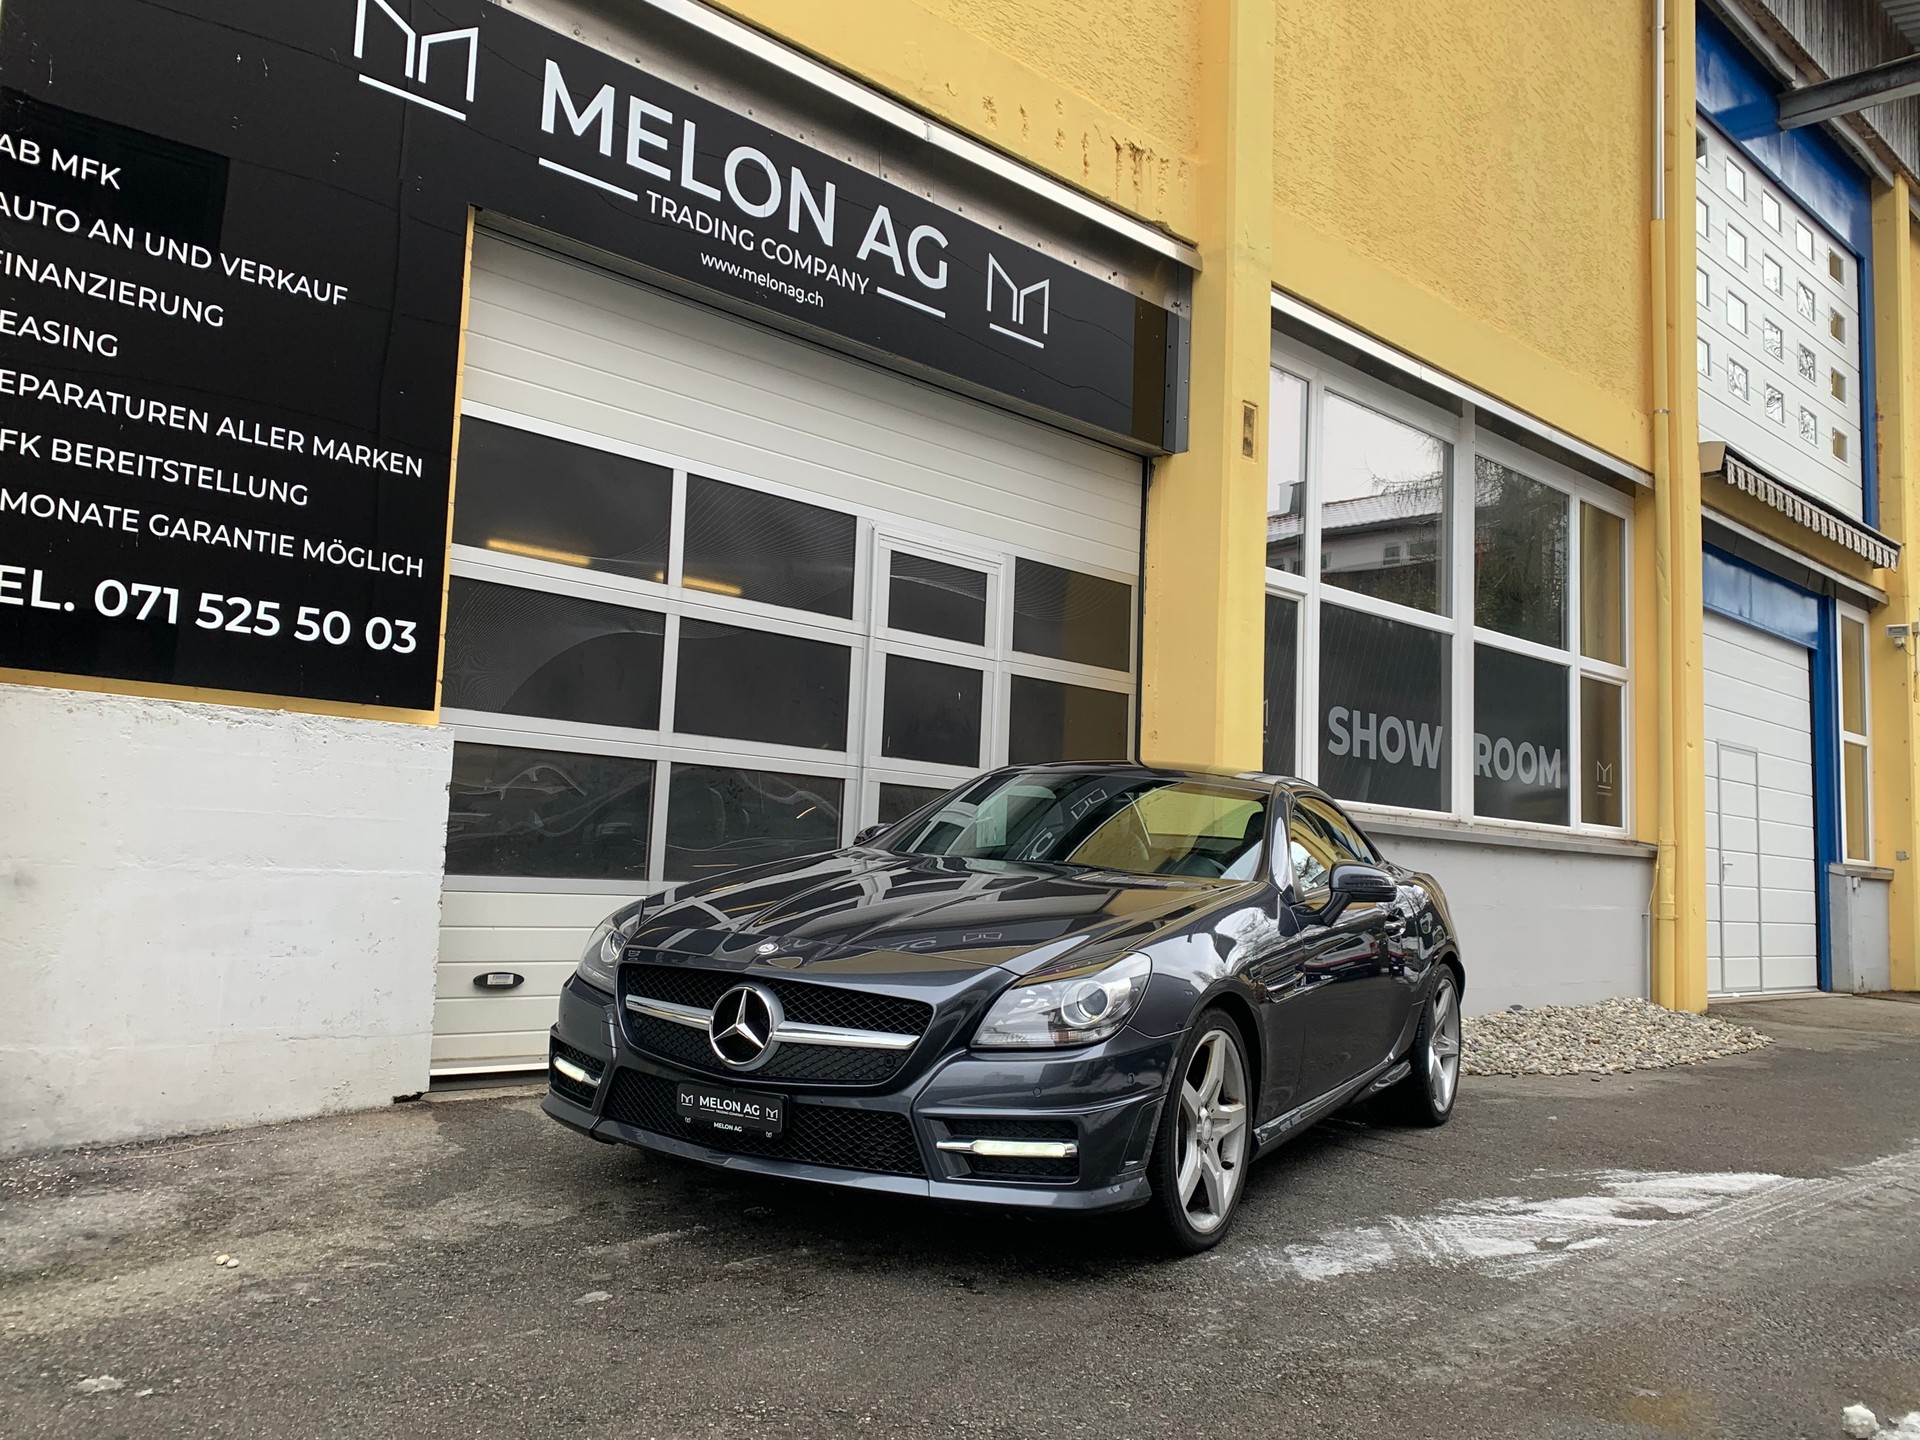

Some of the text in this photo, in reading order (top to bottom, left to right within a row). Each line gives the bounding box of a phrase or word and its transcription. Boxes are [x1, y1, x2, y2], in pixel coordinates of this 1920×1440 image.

[0, 133, 122, 190] AB MFK
[541, 58, 949, 290] MELON AG
[88, 219, 135, 250] AN
[144, 232, 213, 269] UND
[219, 252, 349, 306] VERKAUF
[646, 190, 870, 296] TRADING COMPANY
[700, 252, 825, 309] www.melonag.ch
[0, 250, 225, 328] INANZIERUNG
[51, 438, 309, 506] BEREITSTELLUNG
[215, 416, 305, 454] ALLER
[312, 435, 424, 478] MARKEN
[0, 487, 425, 578] MONATE GARANTIE MÖGLICH
[95, 579, 179, 625] 071
[194, 592, 281, 637] 525
[293, 606, 352, 645] 50
[365, 617, 418, 655] 03
[1328, 705, 1561, 790] SHOW ROOM
[699, 1095, 741, 1113] MELON
[743, 1103, 760, 1117] AG
[713, 1121, 733, 1131] MELON
